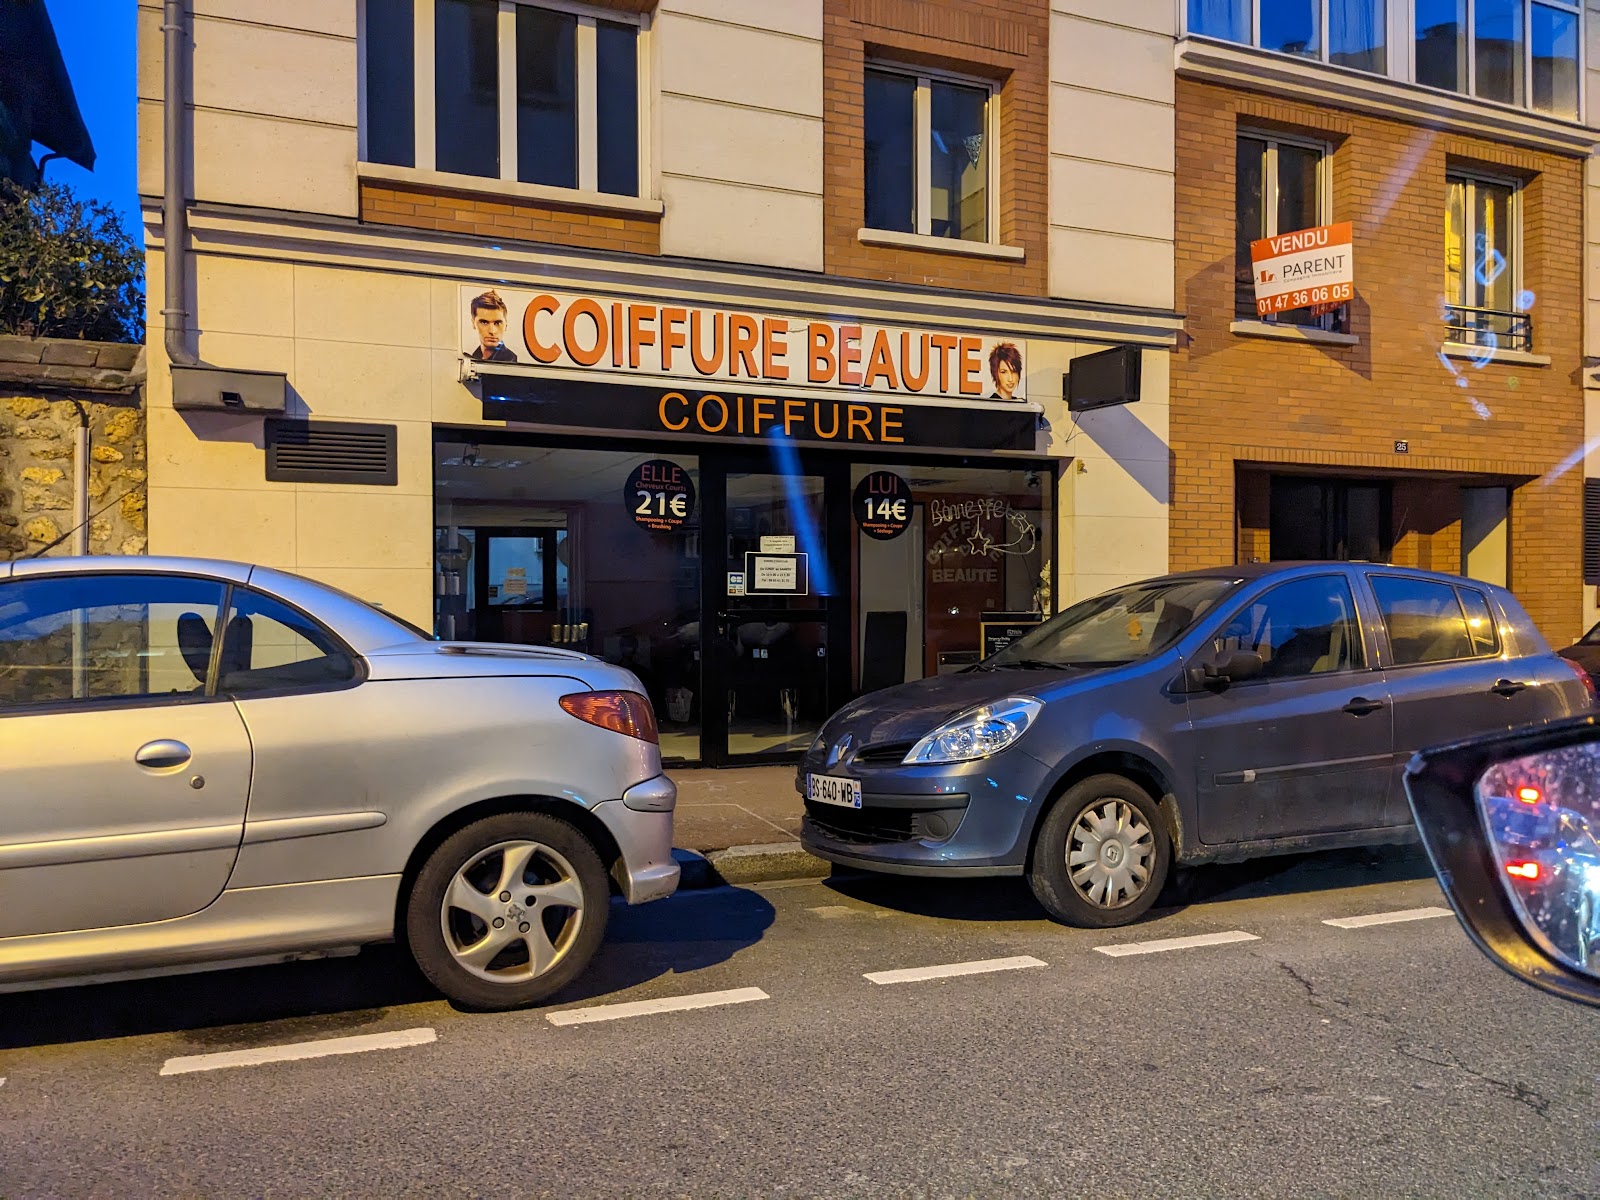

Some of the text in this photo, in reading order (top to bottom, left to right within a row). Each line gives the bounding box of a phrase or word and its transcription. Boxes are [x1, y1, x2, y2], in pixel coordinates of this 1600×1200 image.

[1270, 229, 1328, 255] VENDU
[1283, 255, 1345, 278] PARENT
[1259, 284, 1350, 313] 01 47 36 06 05
[522, 294, 983, 395] COIFFURE BEAUTE
[658, 392, 905, 443] COIFFURE
[1396, 442, 1407, 451] 25
[641, 464, 682, 484] ELLE
[869, 475, 898, 494] LUI
[635, 481, 687, 492] Cheveux Courts
[635, 490, 687, 517] 21€
[864, 498, 906, 521] 14€
[932, 568, 998, 583] BEAUTE
[812, 777, 853, 804] BS-640-WB
